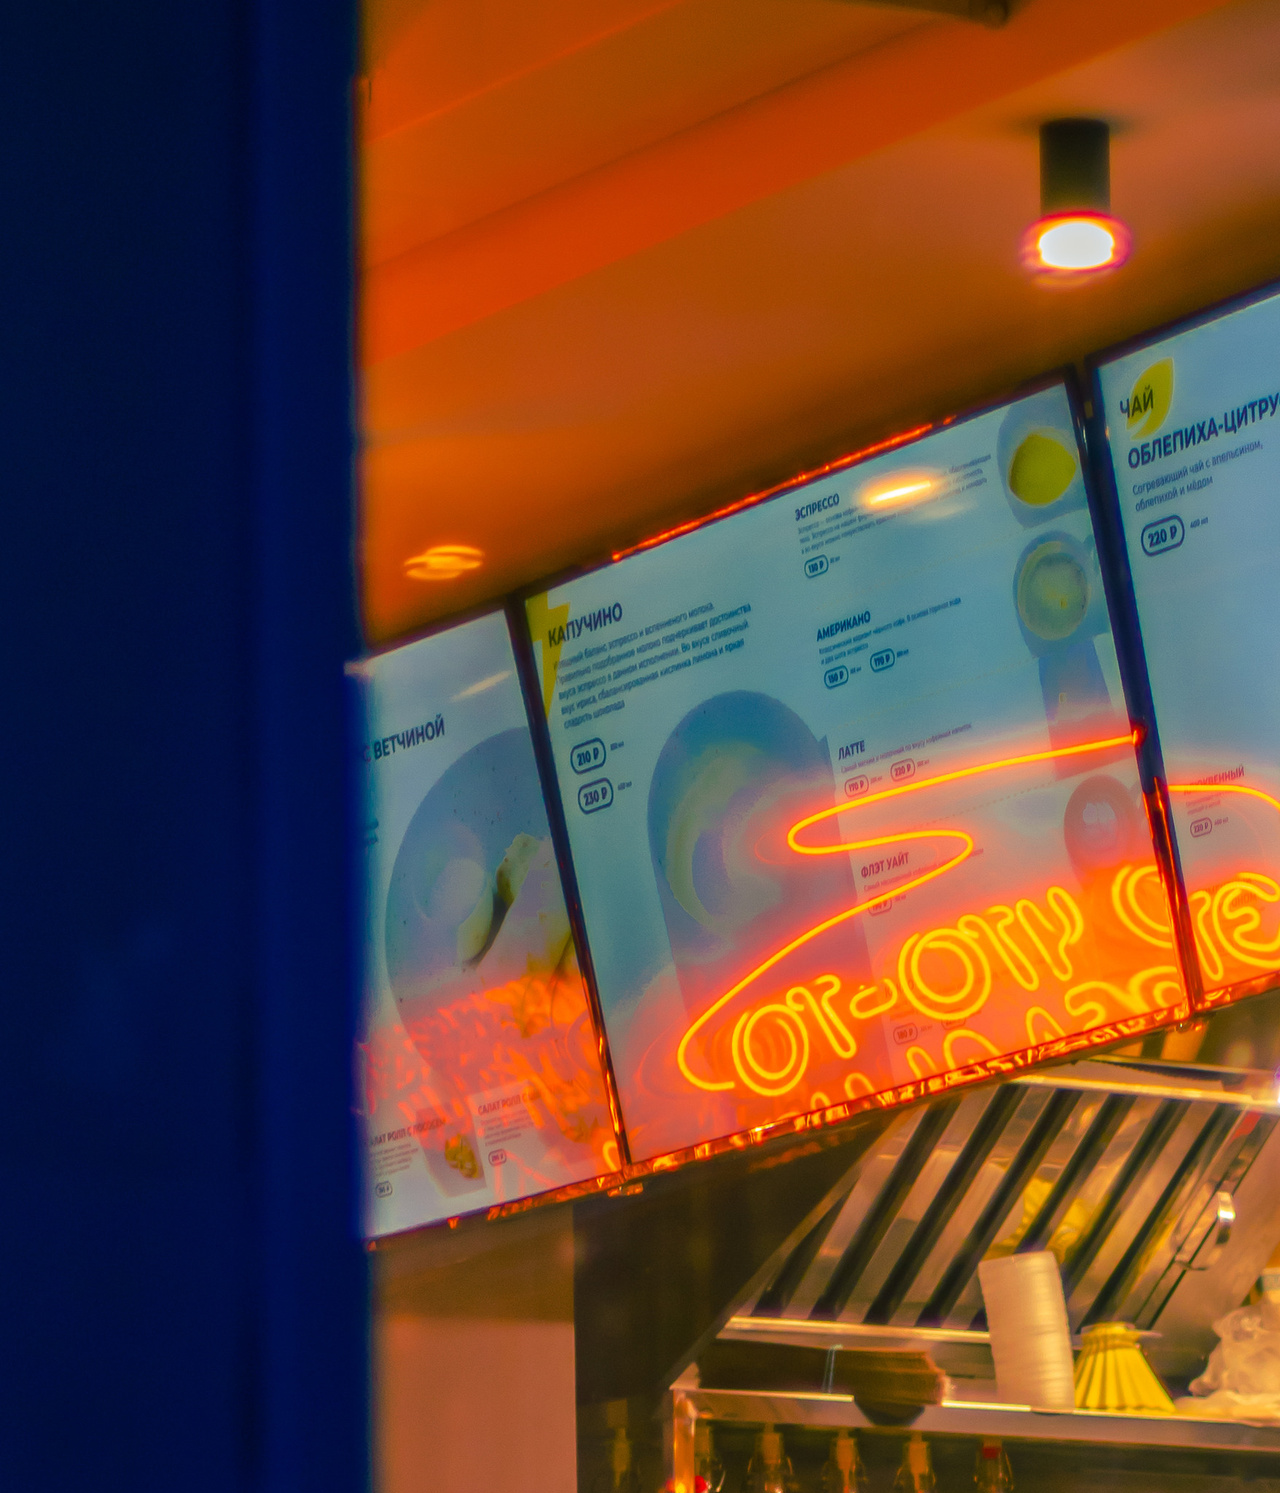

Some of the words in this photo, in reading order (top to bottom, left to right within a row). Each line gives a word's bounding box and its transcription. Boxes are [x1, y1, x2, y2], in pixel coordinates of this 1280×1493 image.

[1119, 384, 1154, 419] ЧАЙ
[1132, 465, 1189, 496] Согревающий
[1189, 460, 1204, 475] чай
[795, 493, 840, 521] ЭСПРЕССО
[1135, 487, 1179, 512] облепихой
[1147, 528, 1168, 548] 220
[548, 602, 623, 648] КАПУЧИНО
[817, 610, 871, 642] АМЕРИКАНО
[373, 713, 446, 760] ВЕТЧИНОЙ
[838, 740, 866, 760] ЛАТТЕ
[860, 860, 885, 879] ФЛЭТ
[886, 851, 909, 871] УАЙТ
